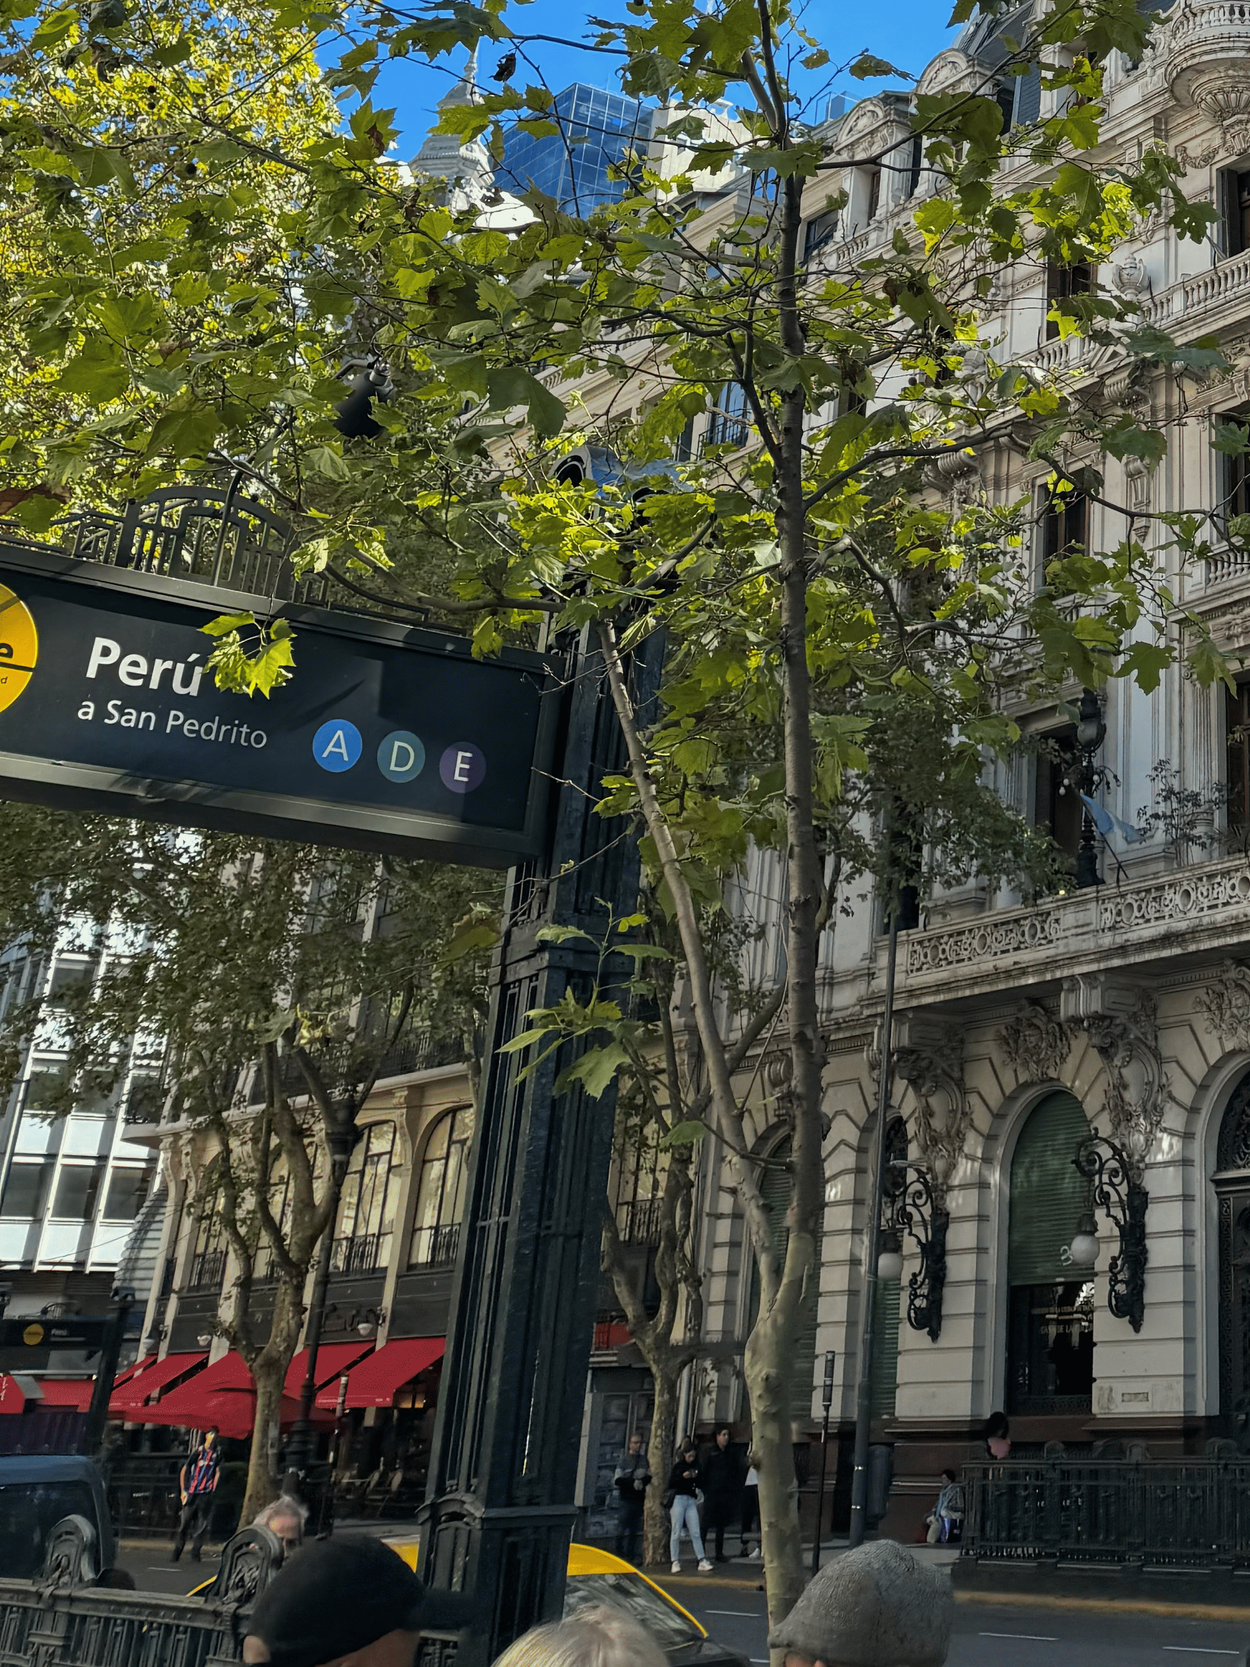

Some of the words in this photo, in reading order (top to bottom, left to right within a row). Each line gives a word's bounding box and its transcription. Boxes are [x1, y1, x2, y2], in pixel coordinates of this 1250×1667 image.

[86, 636, 203, 696] Perú
[77, 700, 95, 721] a
[104, 699, 156, 731] San
[165, 710, 267, 749] Pedrito
[322, 730, 349, 762] A
[389, 741, 415, 772] D
[453, 751, 473, 782] E
